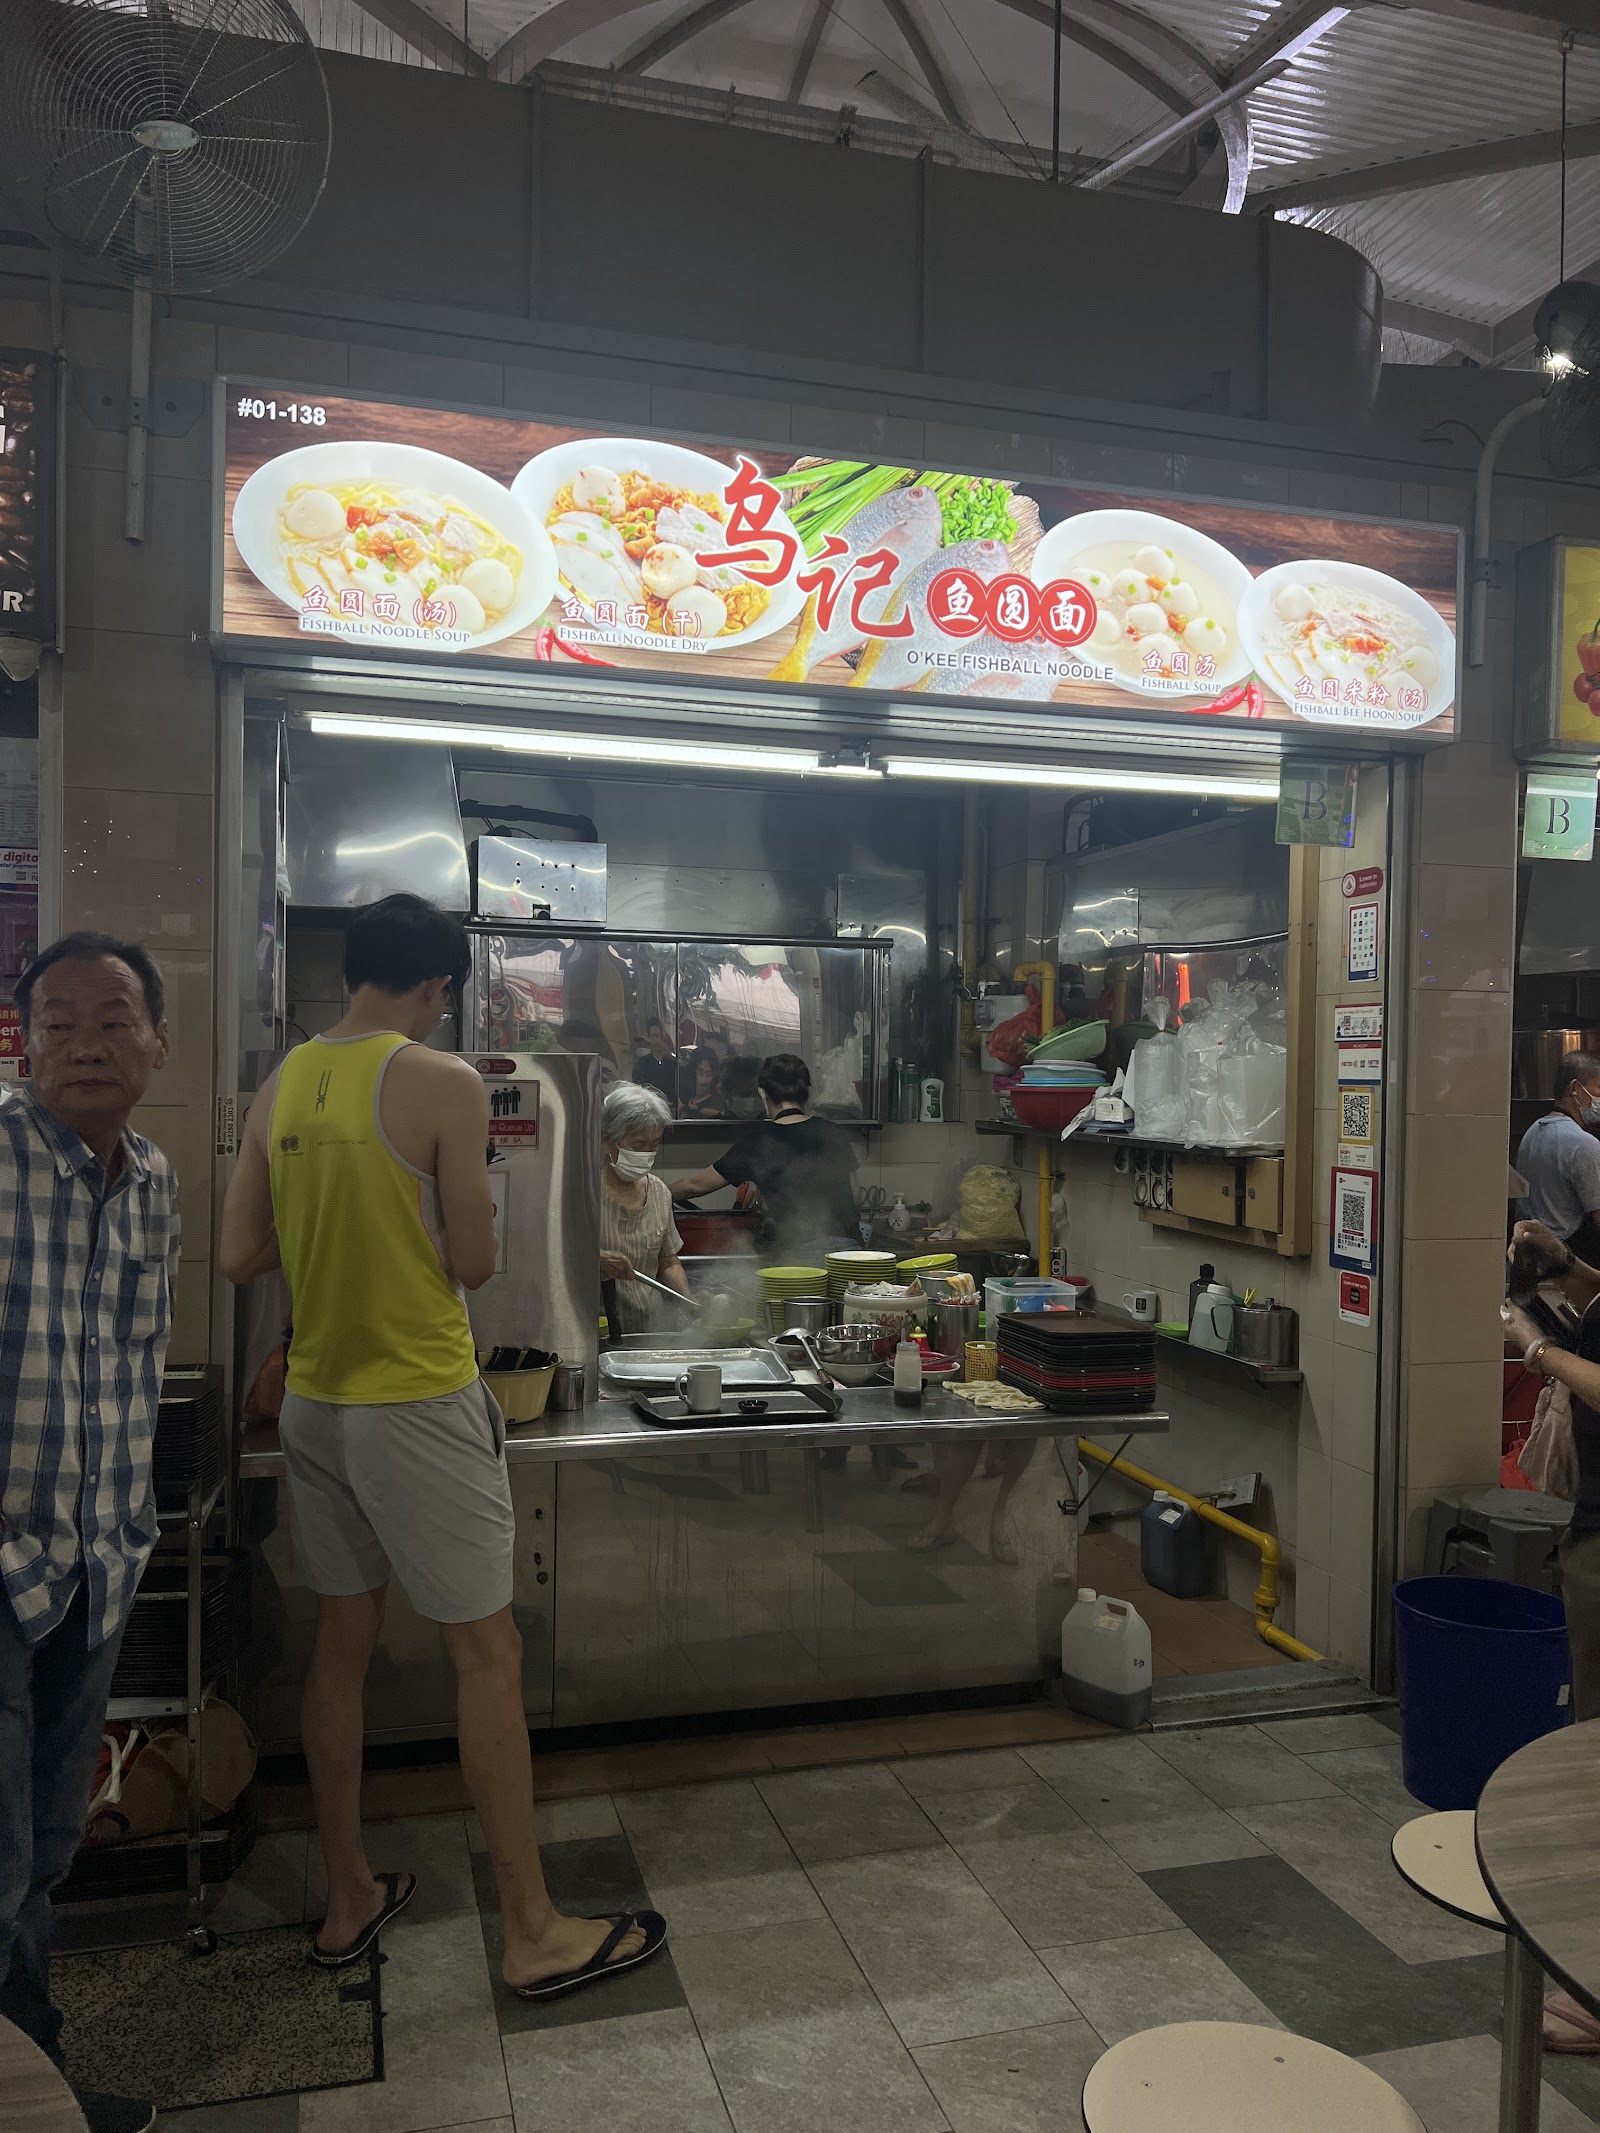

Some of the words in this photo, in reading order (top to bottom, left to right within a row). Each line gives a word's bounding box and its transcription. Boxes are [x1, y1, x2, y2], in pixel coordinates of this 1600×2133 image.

[237, 397, 327, 426] #01-138
[694, 455, 915, 638] 乌记
[938, 577, 1087, 636] 鱼圆面
[301, 617, 367, 634] FISHBALL
[370, 623, 430, 640] NOODLE
[434, 628, 471, 643] SOUP
[559, 627, 619, 643] FISHBALL
[622, 633, 678, 649] NOODLE
[681, 638, 708, 651] DRY
[907, 650, 958, 668] O'KEE
[962, 654, 1042, 675] FISHBALL
[1046, 662, 1114, 680] NOODLE
[1142, 649, 1217, 679] 鱼圆汤
[1142, 676, 1191, 691] FISHBALL
[1193, 680, 1222, 693] SOUP
[1294, 702, 1340, 716] FISHBALL
[1343, 706, 1360, 717] BEE
[1363, 707, 1395, 719] HOON
[1398, 711, 1424, 722] SOUP
[1300, 781, 1328, 820] B
[1545, 797, 1570, 835] B
[499, 1122, 523, 1132] Queue
[525, 1123, 534, 1133] Up
